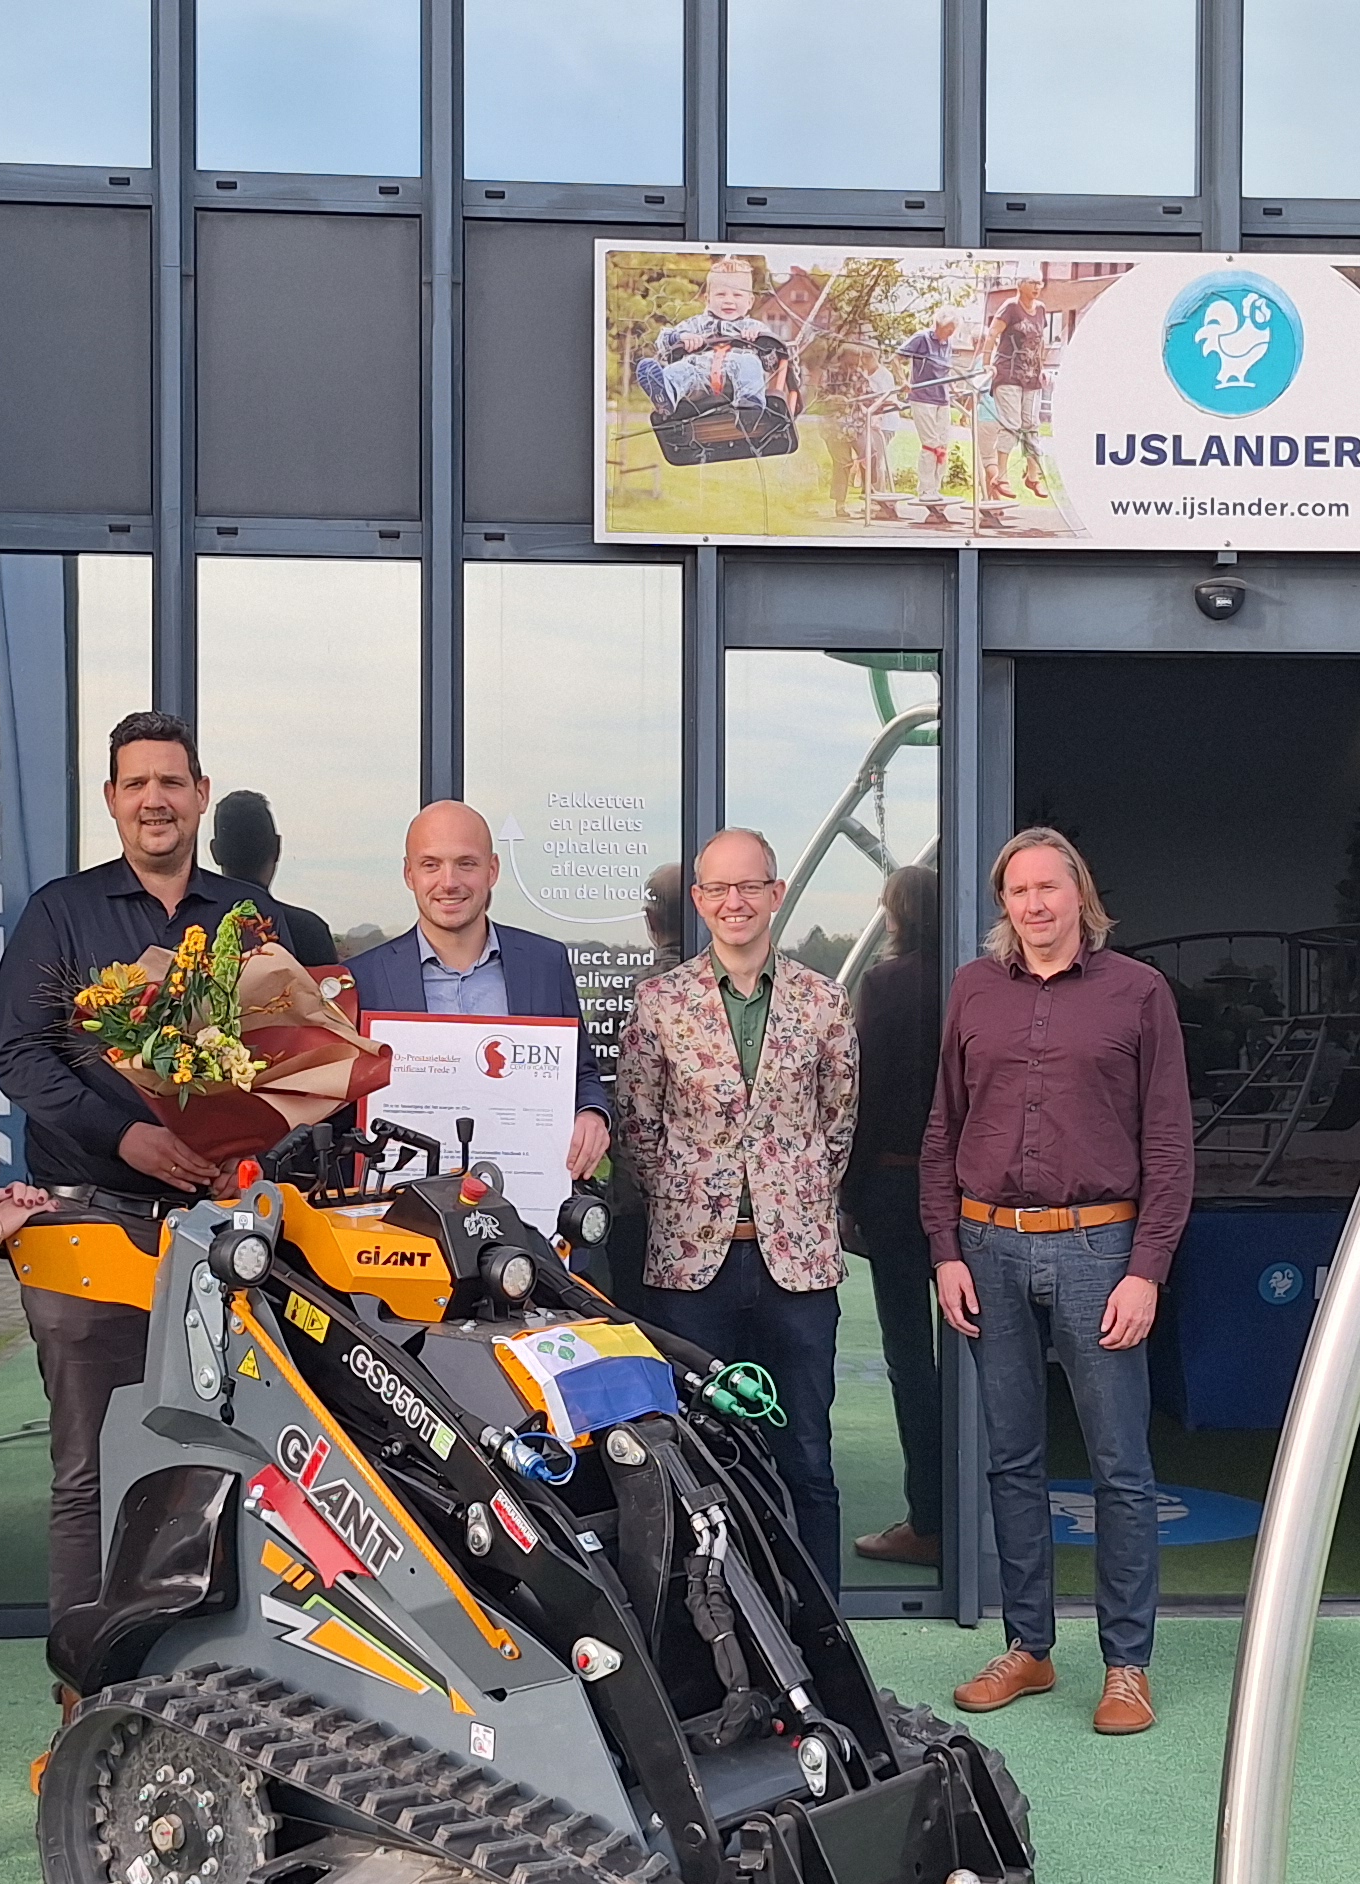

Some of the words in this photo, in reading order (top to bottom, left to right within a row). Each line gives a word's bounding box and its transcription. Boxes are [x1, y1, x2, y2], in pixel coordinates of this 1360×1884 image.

[1110, 497, 1350, 520] www.ijslander.com
[548, 791, 646, 809] Pakketten
[549, 817, 573, 831] en
[579, 815, 643, 835] pallets
[543, 837, 620, 858] ophalen
[625, 841, 649, 855] en
[551, 860, 641, 877] afleveren
[540, 886, 570, 899] om
[575, 884, 599, 899] de
[603, 883, 658, 901] hoek.
[616, 949, 655, 966] and
[574, 971, 634, 989] eliver
[577, 995, 634, 1012] arcels
[511, 1044, 563, 1065] EBN
[349, 1344, 458, 1462] GS950TE
